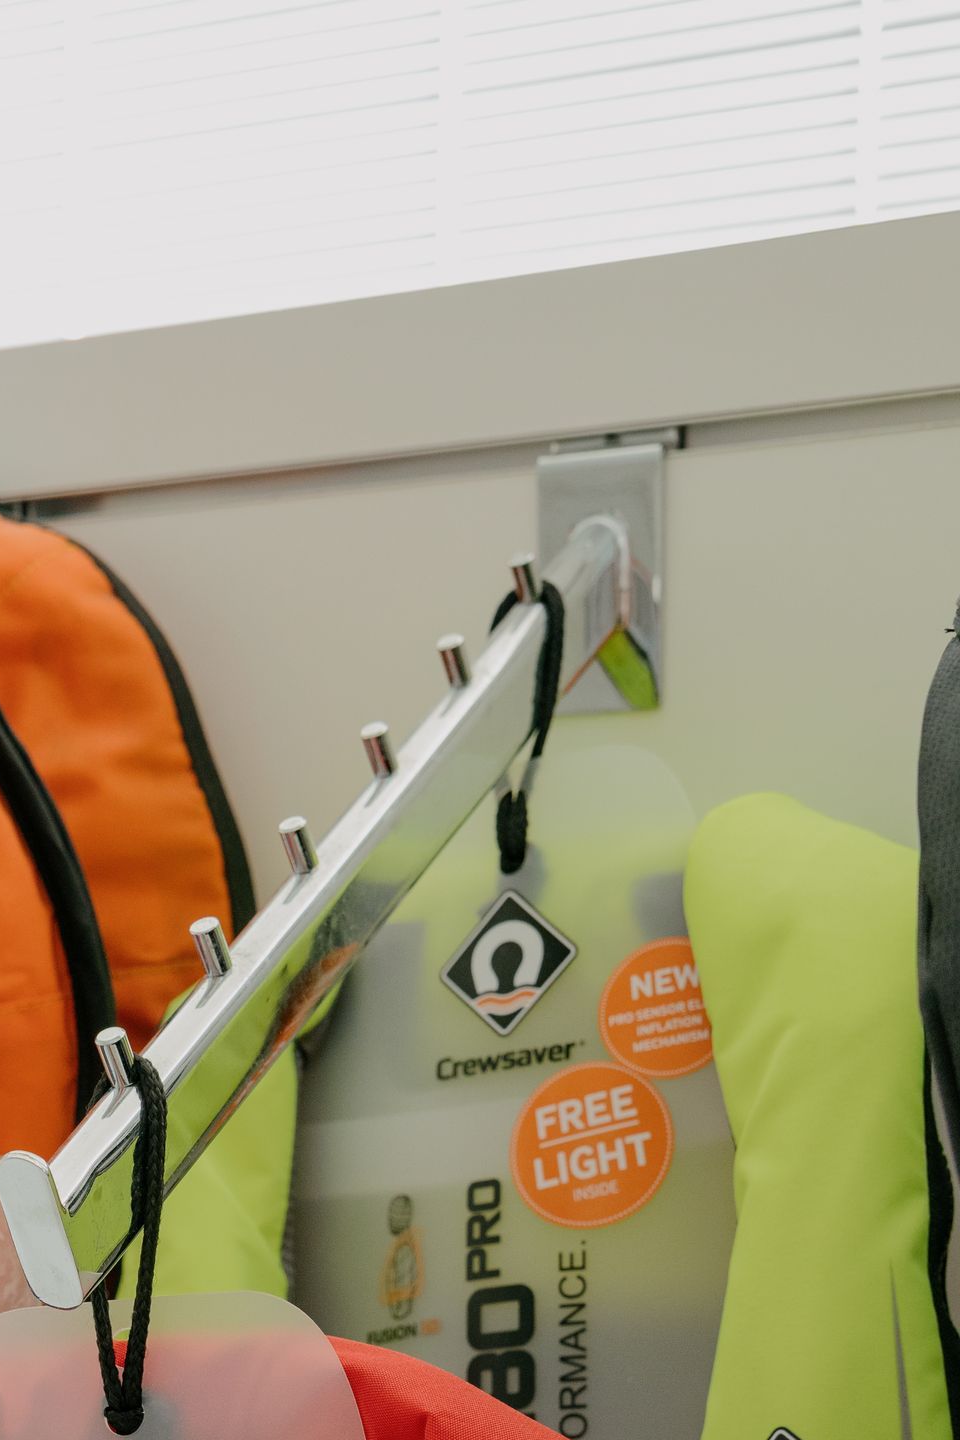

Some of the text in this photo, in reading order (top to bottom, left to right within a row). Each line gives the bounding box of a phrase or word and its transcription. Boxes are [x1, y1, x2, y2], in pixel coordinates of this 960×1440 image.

[629, 963, 699, 1001] NEW
[436, 1041, 576, 1080] Crewsaver
[534, 1084, 638, 1140] FREE
[533, 1131, 652, 1191] LIGHT
[572, 1179, 621, 1203] INSIDE
[466, 1178, 536, 1421] 80 PRO
